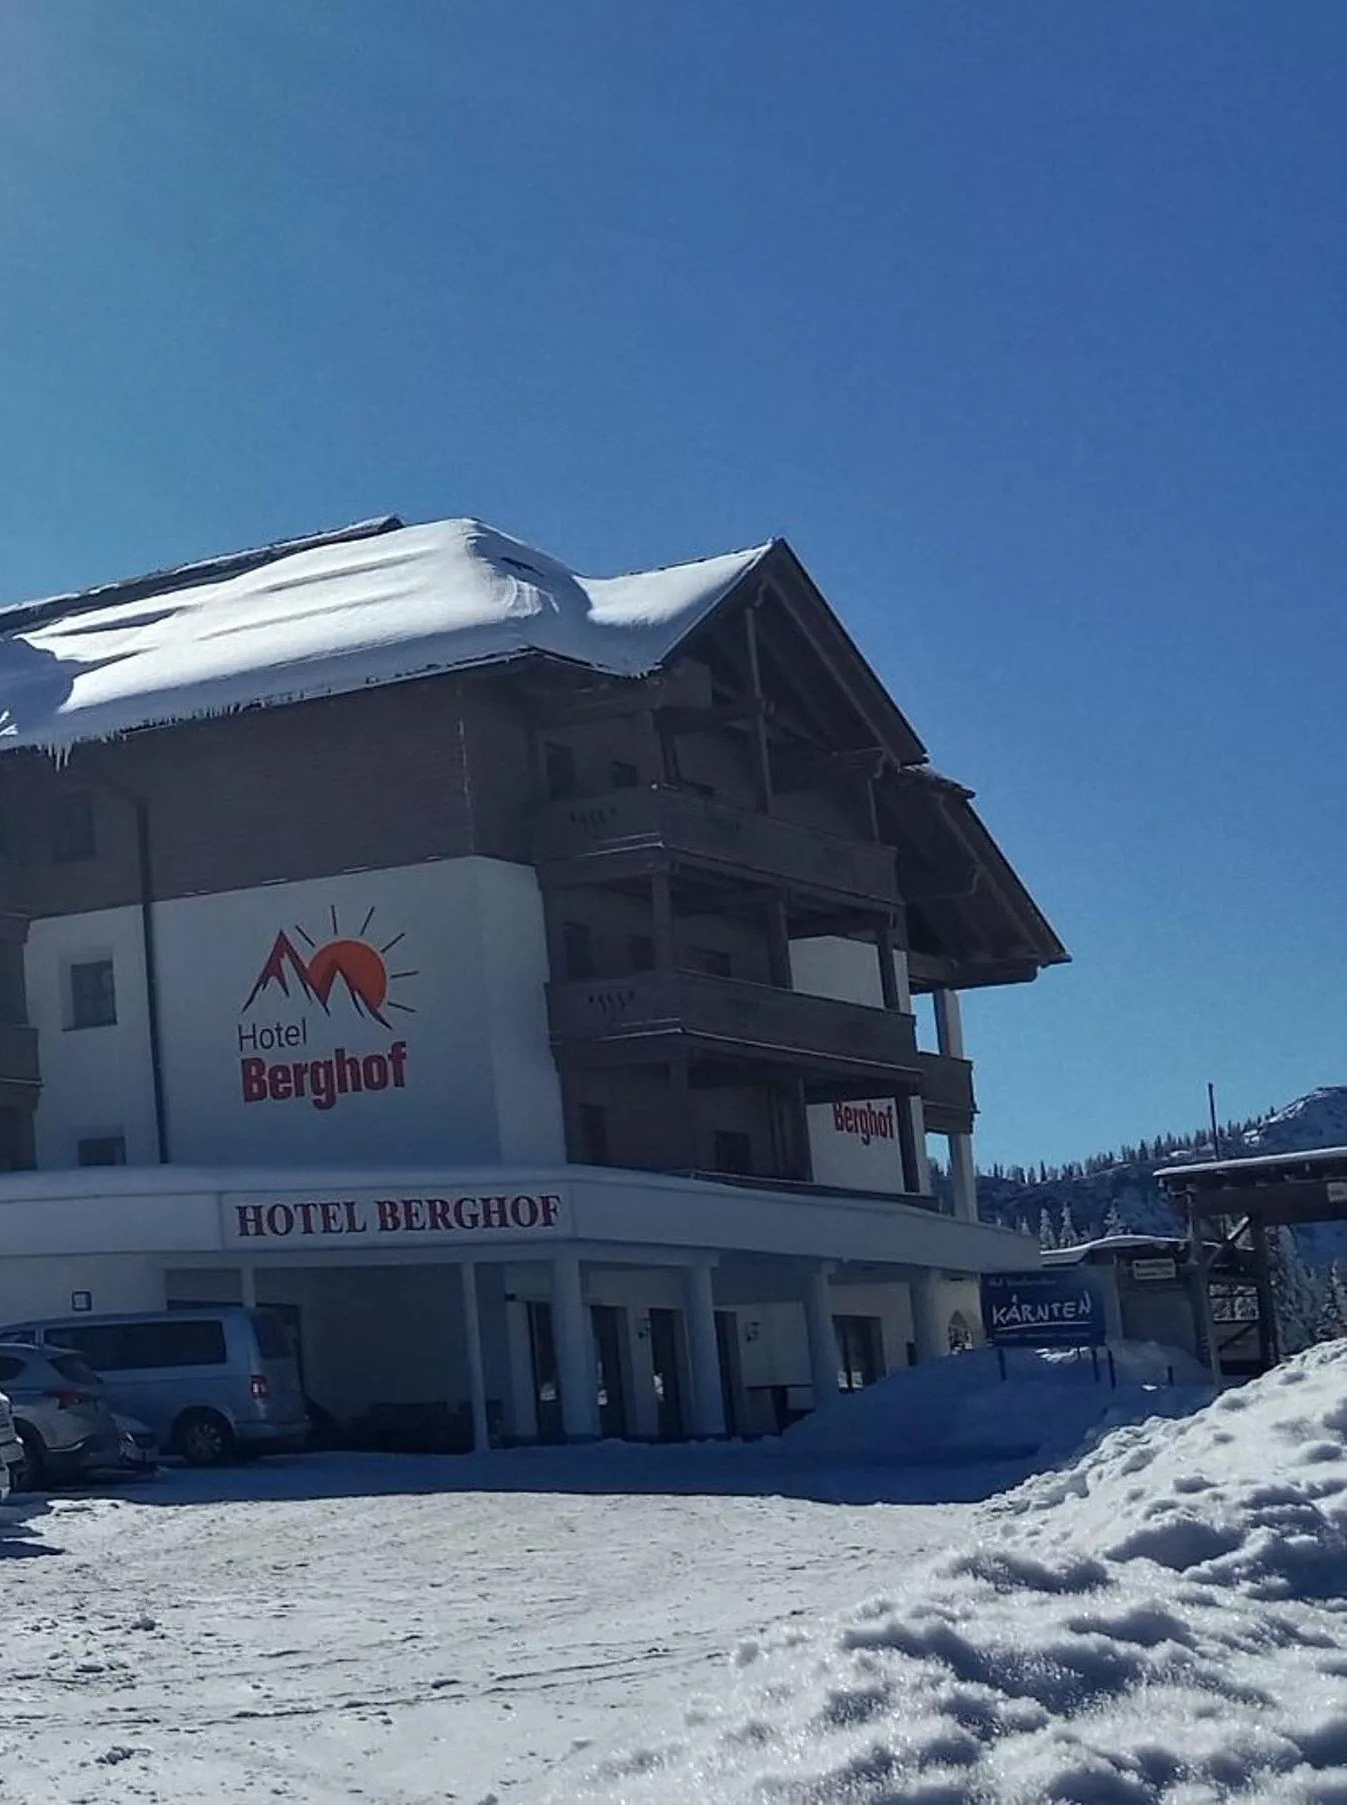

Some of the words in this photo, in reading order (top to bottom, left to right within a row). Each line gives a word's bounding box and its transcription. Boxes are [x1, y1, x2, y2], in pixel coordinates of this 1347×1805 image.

[237, 1018, 306, 1051] Hotel
[240, 1041, 407, 1110] Berghof
[833, 1100, 893, 1146] Berghof
[236, 1201, 367, 1236] HOTEL
[375, 1195, 561, 1232] BERGHOF
